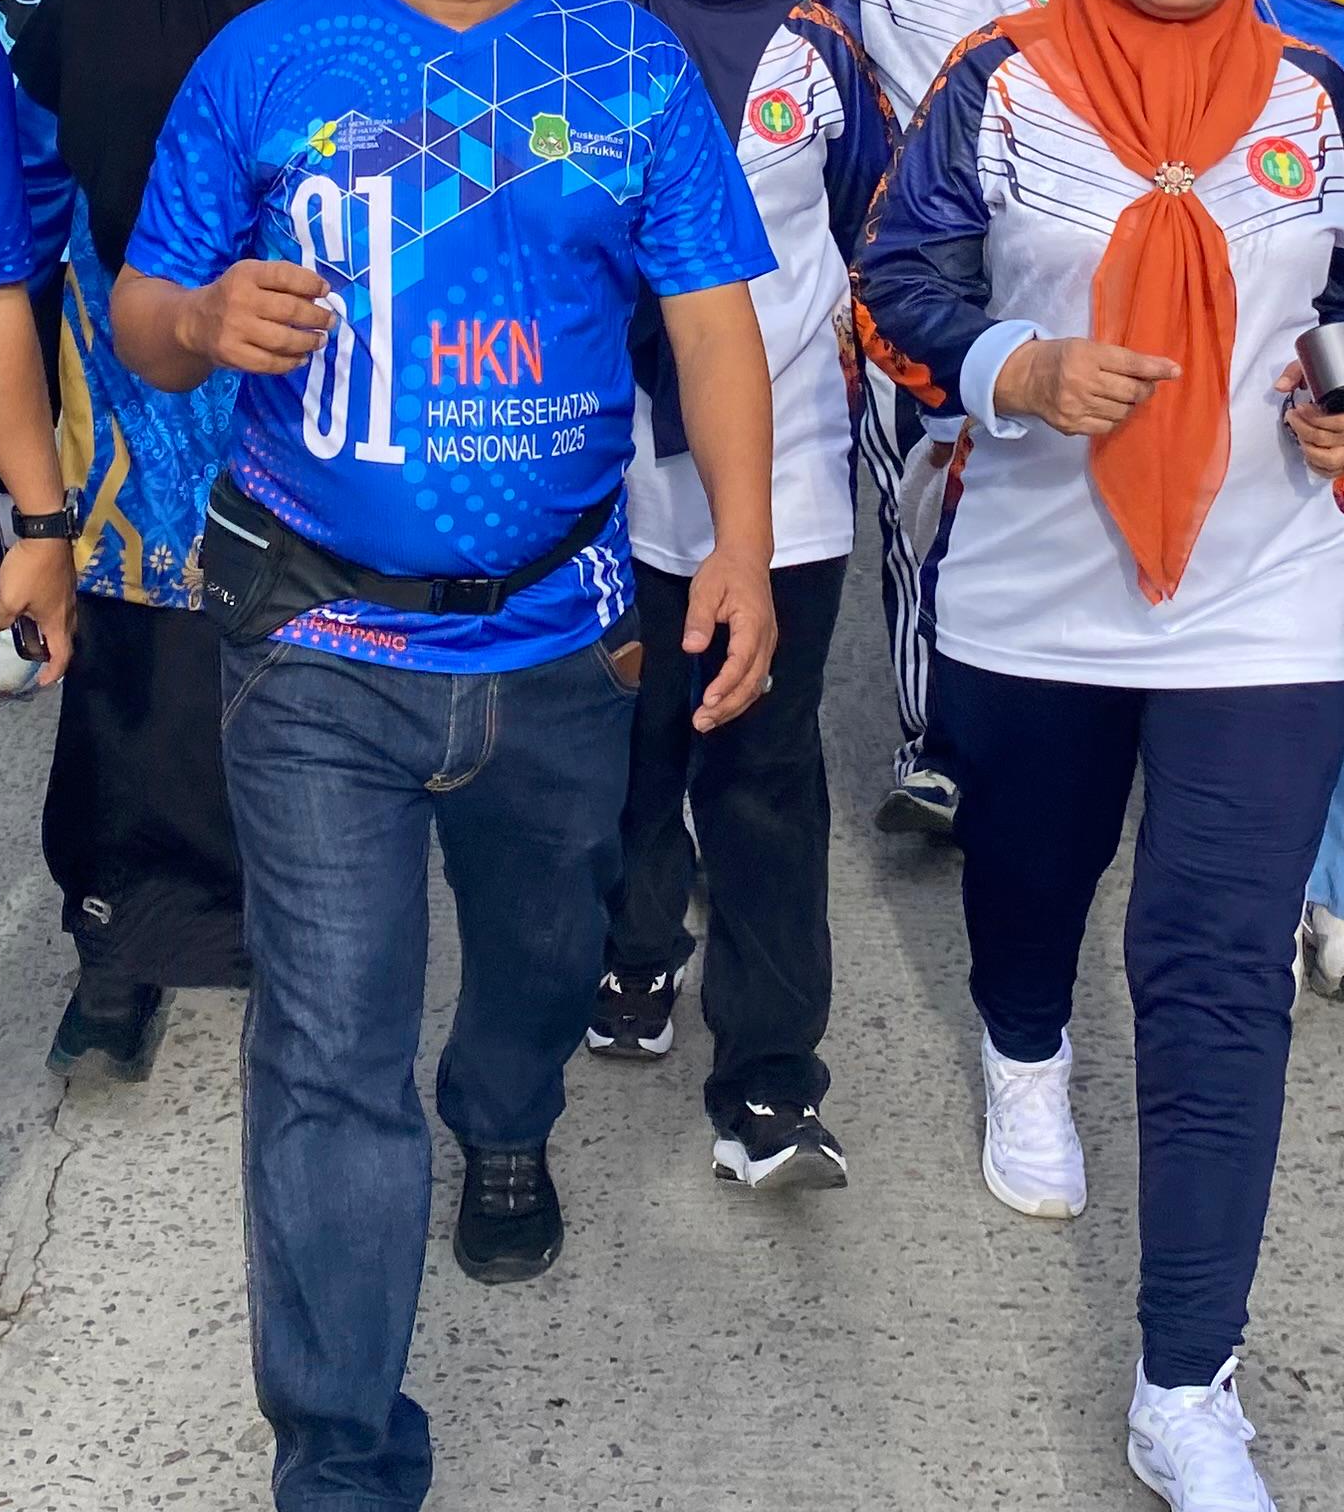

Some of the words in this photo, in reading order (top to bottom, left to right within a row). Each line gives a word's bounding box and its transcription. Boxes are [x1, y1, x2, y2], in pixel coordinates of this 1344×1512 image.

[569, 128, 624, 145] Puskesmas
[572, 141, 623, 160] Barukku
[431, 320, 543, 385] HKN
[427, 399, 484, 428] HARI
[490, 391, 600, 427] KESEHATAN
[426, 433, 543, 464] NASIONAL
[550, 425, 586, 457] 2025
